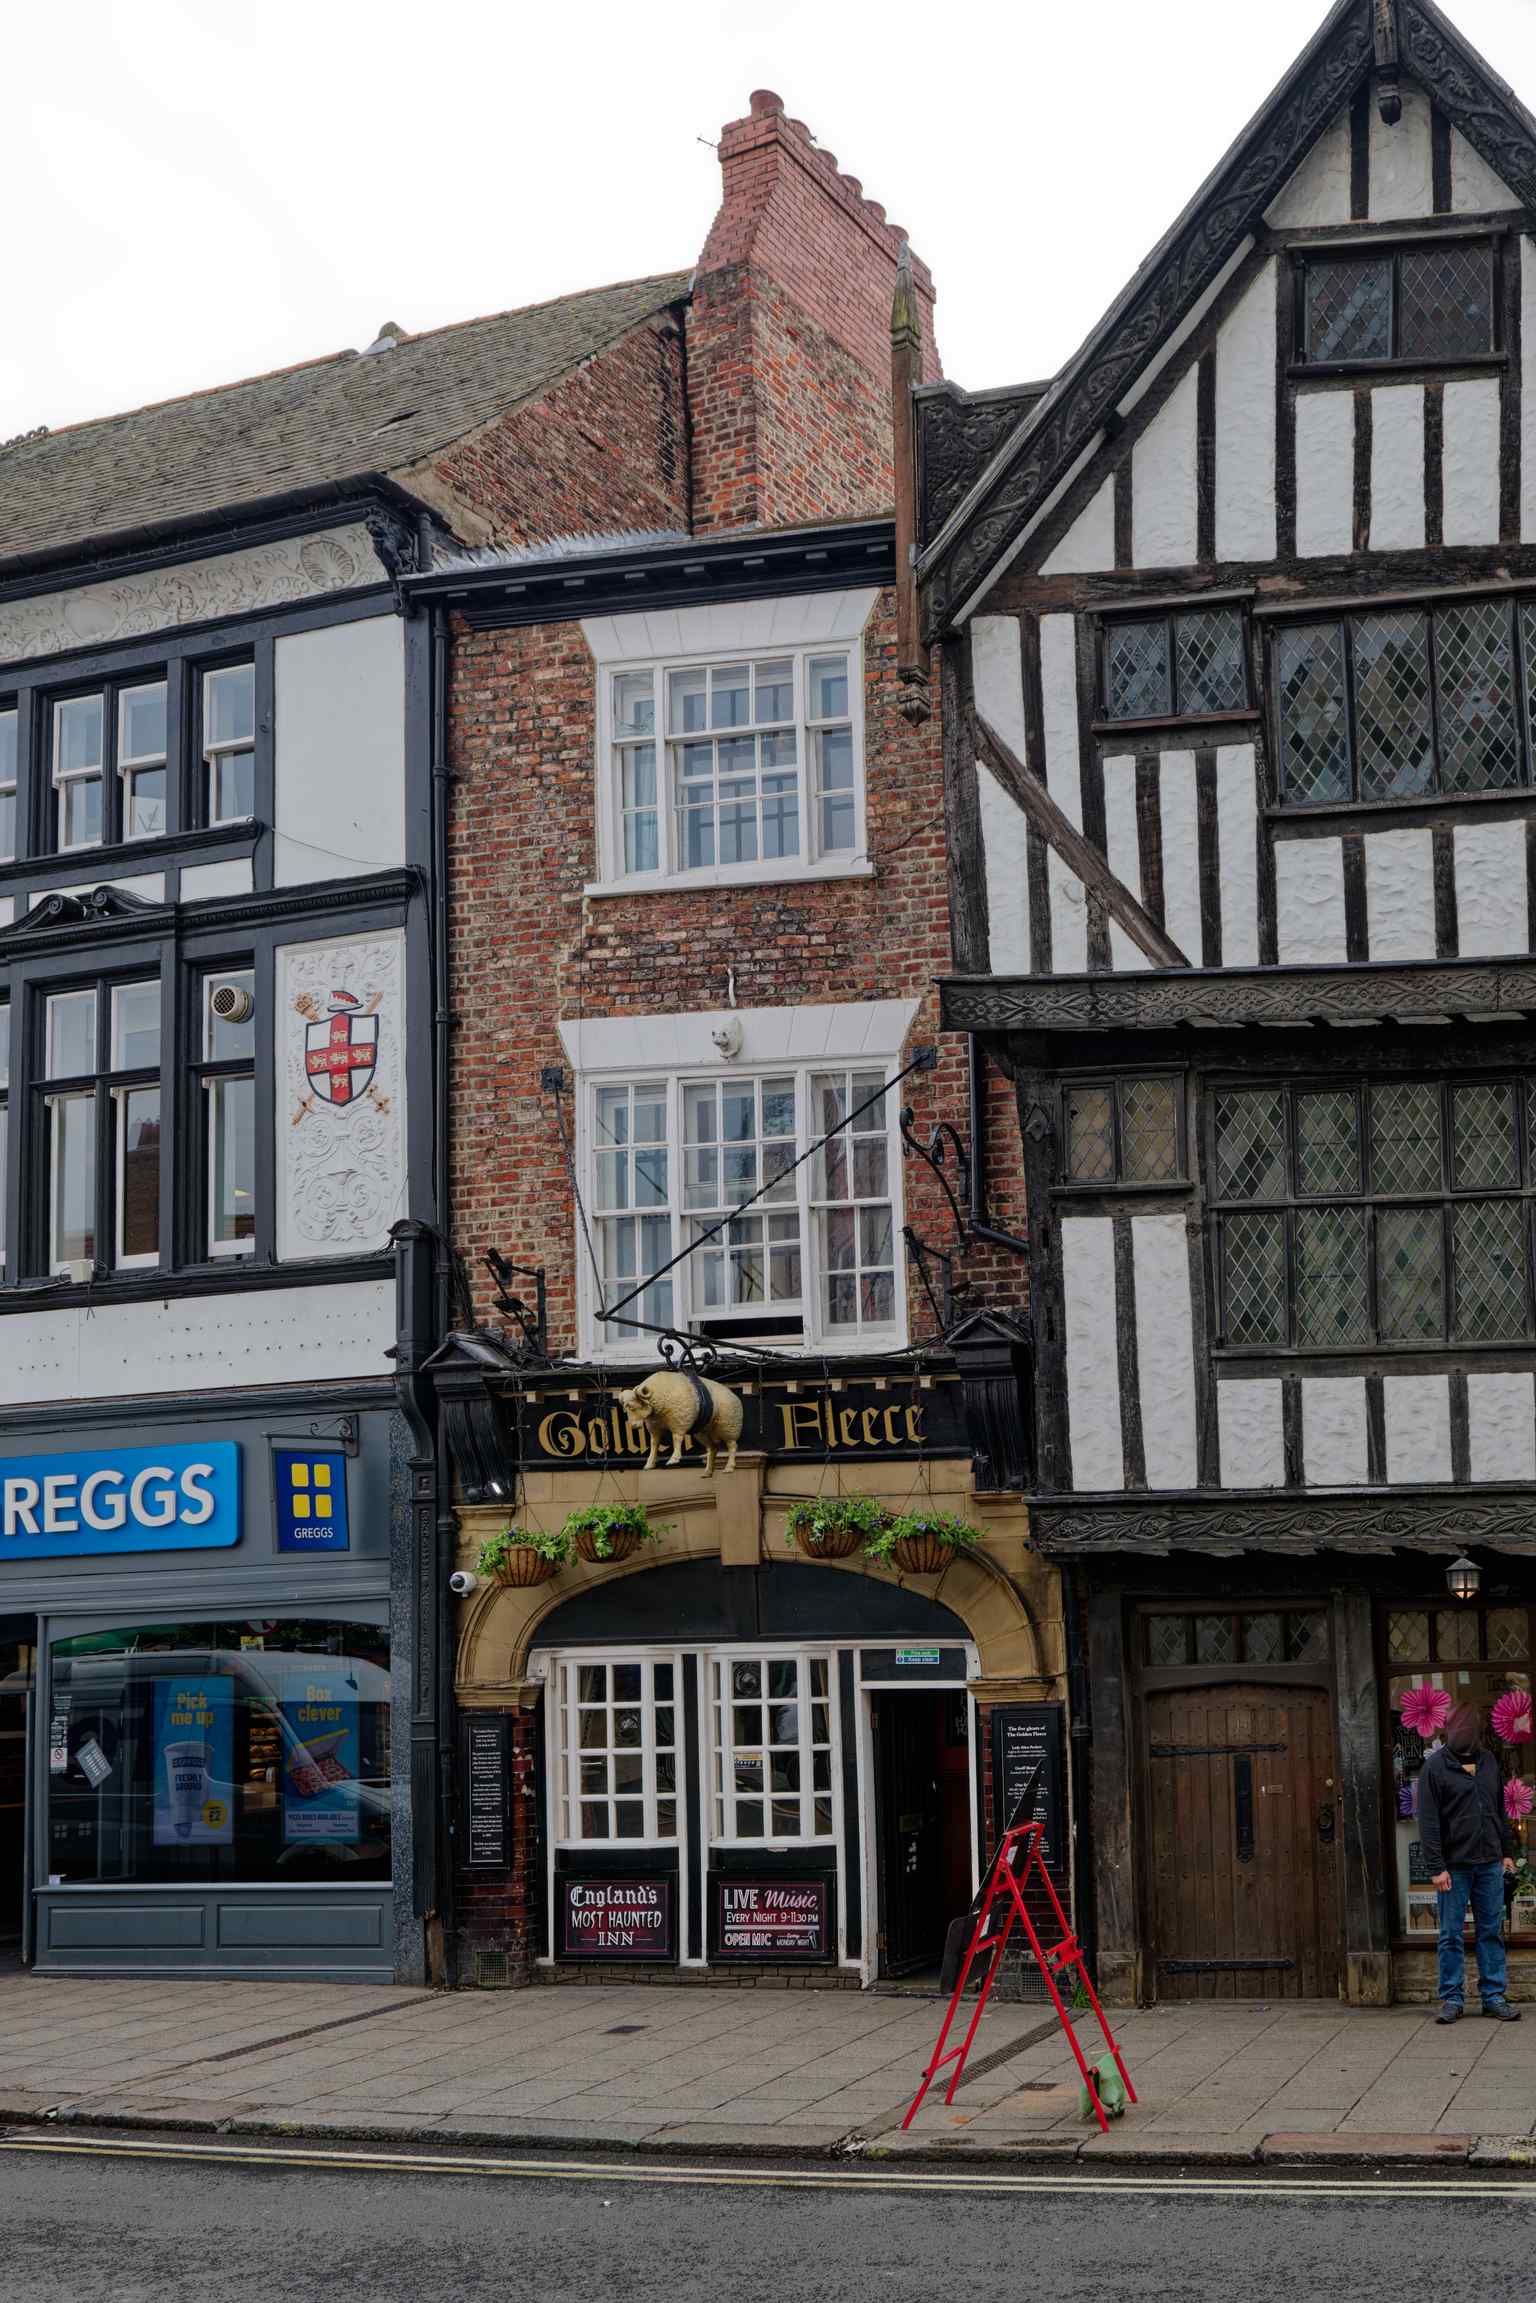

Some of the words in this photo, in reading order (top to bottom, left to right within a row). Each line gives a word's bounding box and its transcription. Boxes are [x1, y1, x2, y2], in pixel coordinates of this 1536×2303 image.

[775, 1398, 928, 1450] Fleece
[294, 1527, 333, 1539] GREGGS
[171, 1711, 192, 1726] me
[298, 1703, 343, 1722] clever
[570, 1885, 657, 1908] England's
[724, 1888, 759, 1910] LIVE
[571, 1910, 604, 1929] MOST
[608, 1910, 662, 1928] HAUNTED
[597, 1931, 635, 1946] INN
[724, 1932, 751, 1946] OPEN
[751, 1932, 772, 1946] MIC
